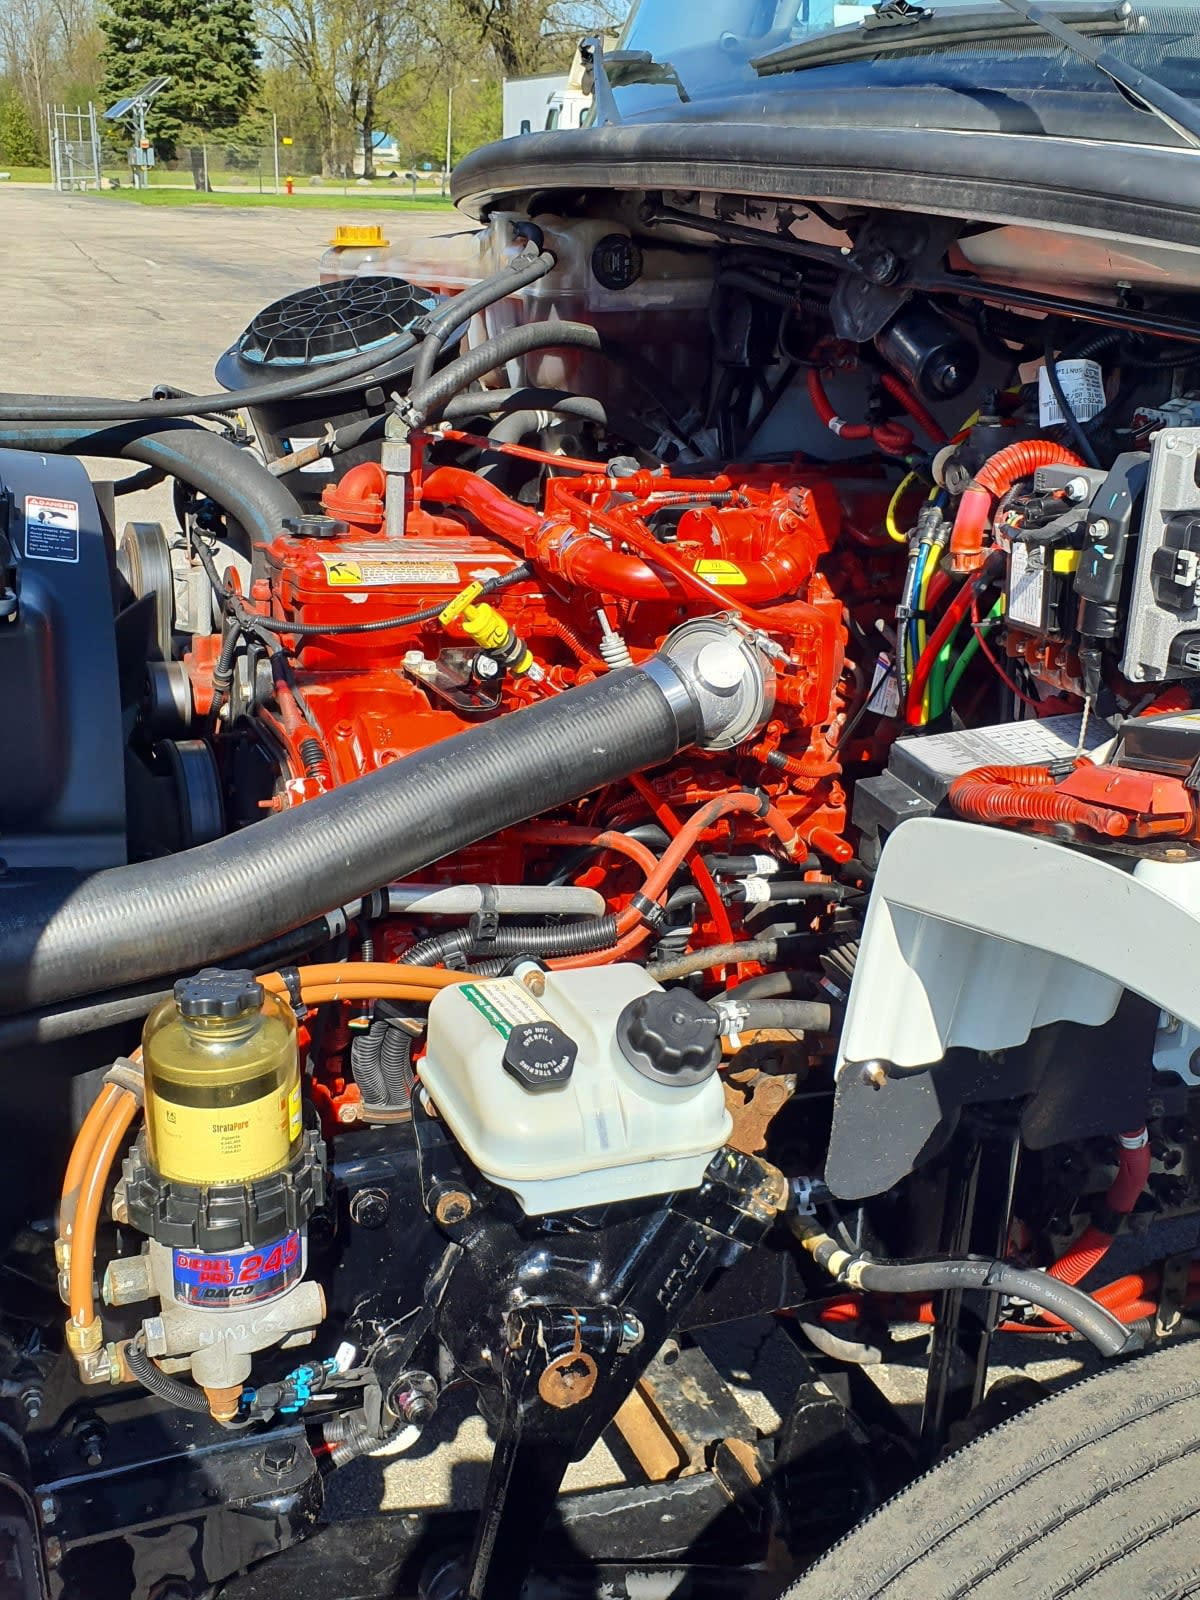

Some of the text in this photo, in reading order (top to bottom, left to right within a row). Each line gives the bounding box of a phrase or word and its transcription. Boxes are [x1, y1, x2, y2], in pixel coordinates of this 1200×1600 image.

[39, 500, 76, 510] DANGER
[523, 1027, 549, 1037] DO NOT
[522, 1033, 554, 1047] OVERFILL
[519, 1055, 570, 1077] POWER STEERING
[534, 1059, 558, 1069] FLUID
[176, 1254, 234, 1273] DIESEL
[199, 1231, 300, 1285] PRO 245
[204, 1285, 254, 1298] DAVCO
